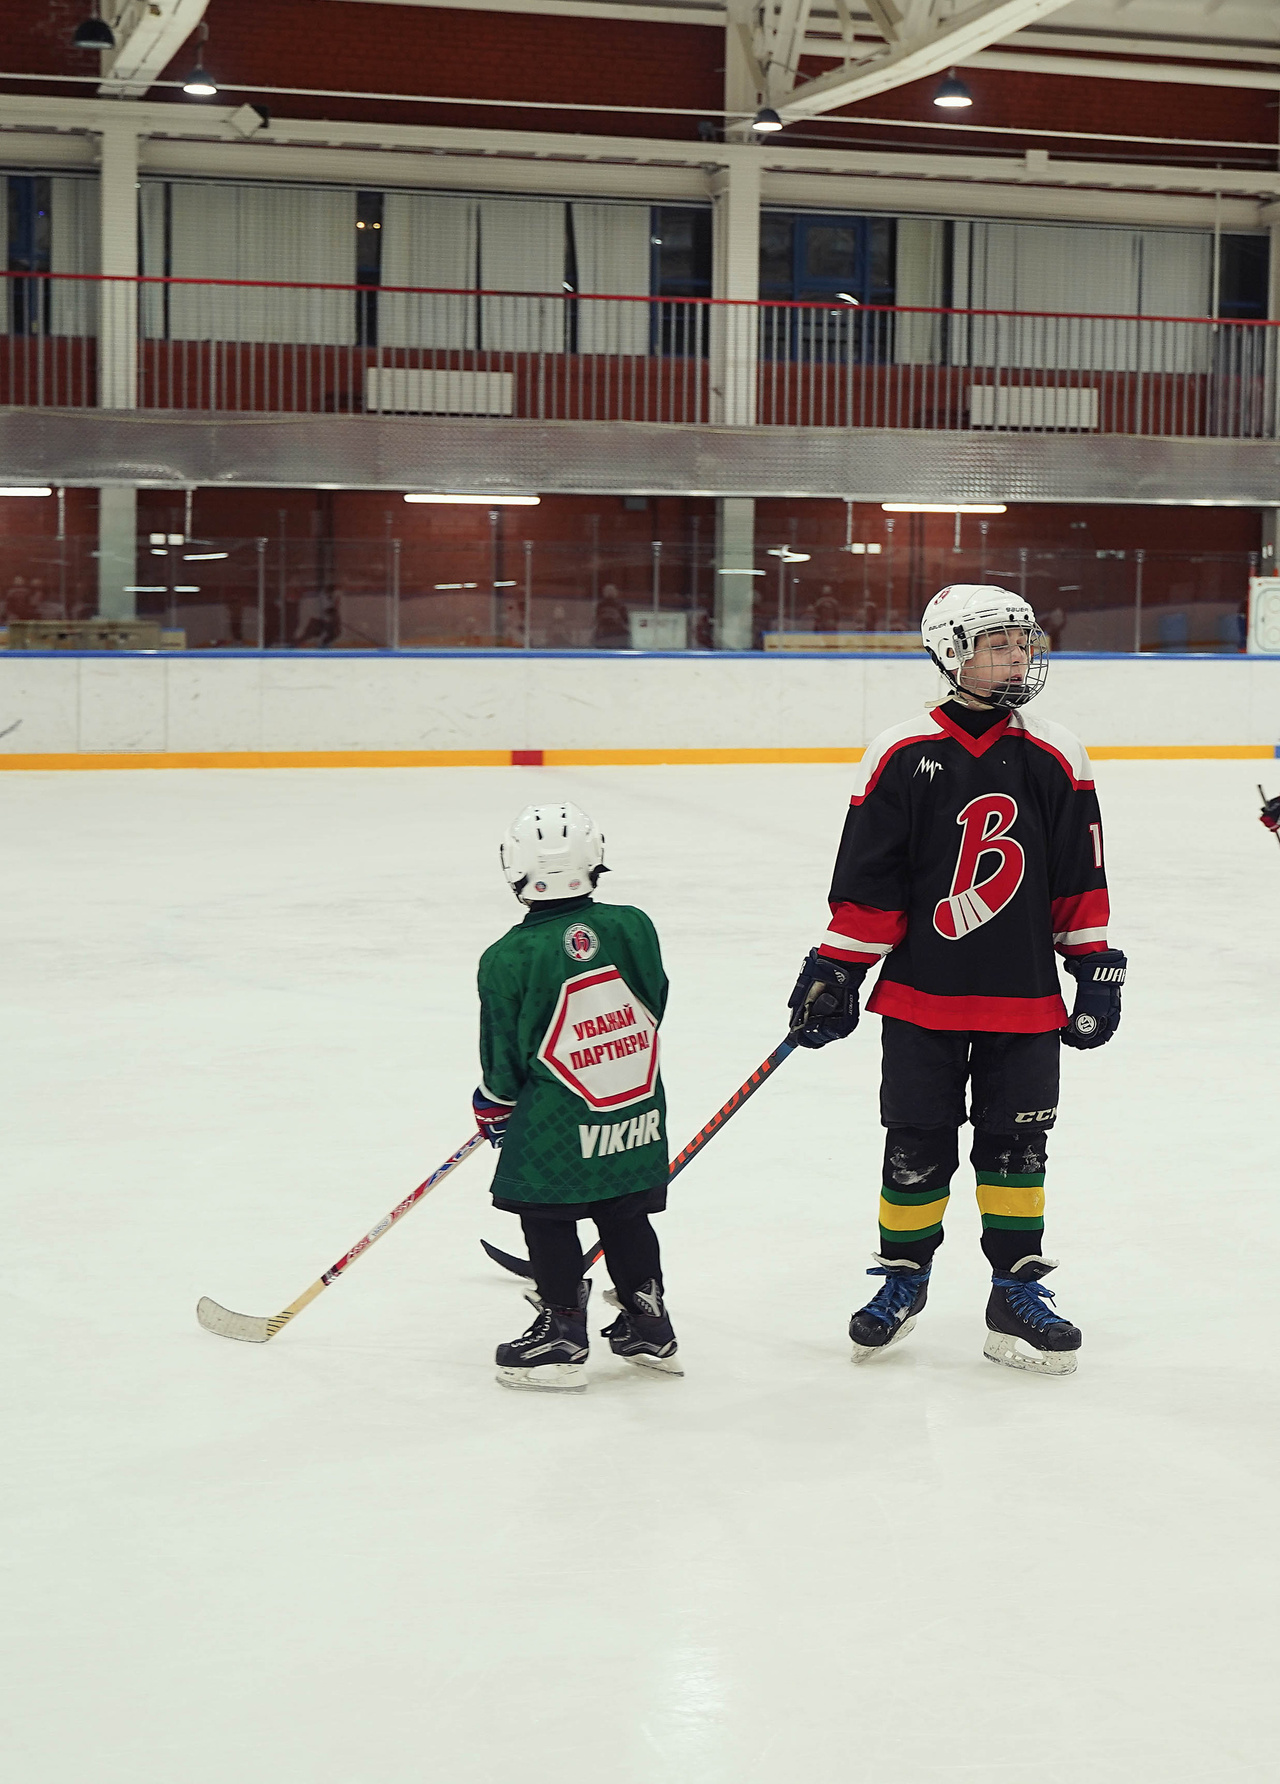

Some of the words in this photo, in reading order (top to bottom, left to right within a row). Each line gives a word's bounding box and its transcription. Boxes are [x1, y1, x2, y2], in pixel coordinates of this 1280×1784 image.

[572, 1004, 636, 1042] УВАЖАЙ
[569, 1030, 650, 1070] ПАРТНЕРА!
[578, 1109, 661, 1159] VIKHR
